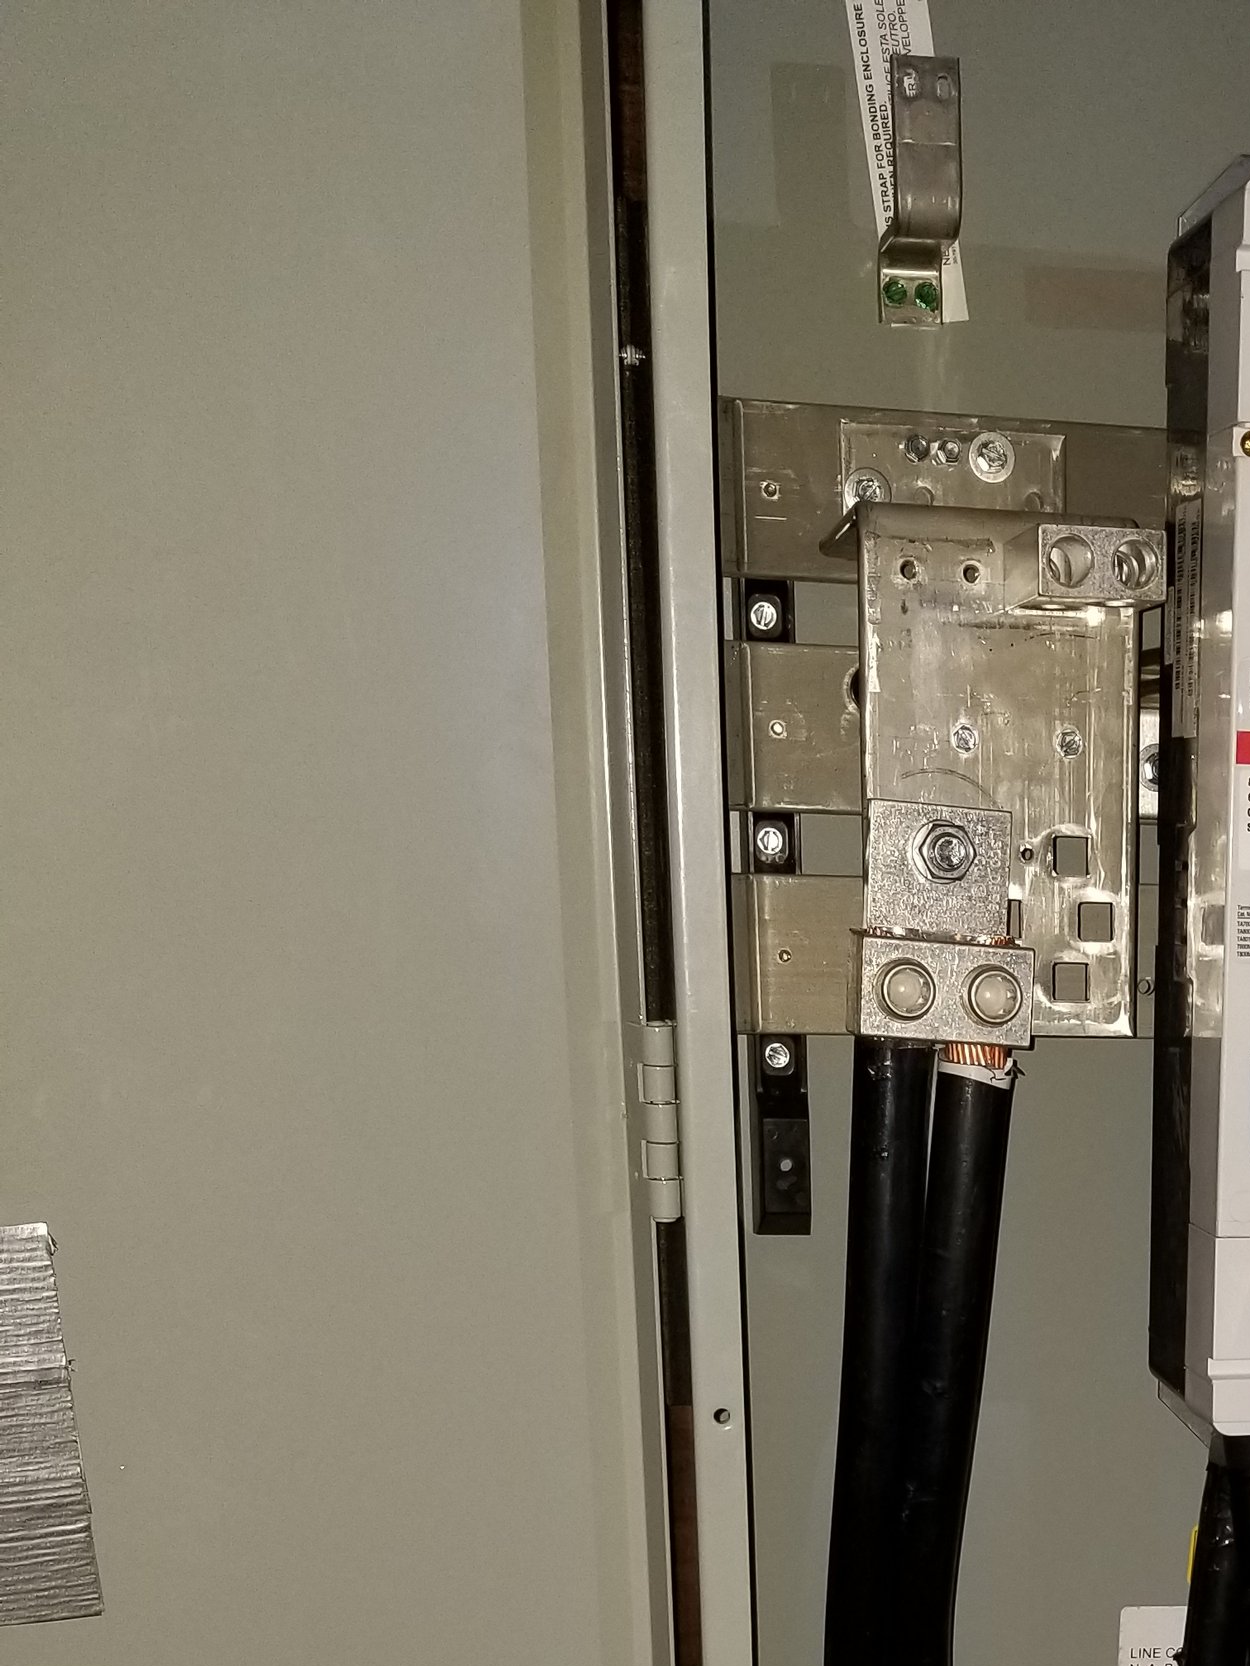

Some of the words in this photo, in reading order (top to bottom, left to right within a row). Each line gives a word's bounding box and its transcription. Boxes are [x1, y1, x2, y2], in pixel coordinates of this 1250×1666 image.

[853, 3, 873, 81] ENCLOSURE
[888, 11, 902, 55] EUTRO.
[865, 83, 882, 142] BONDING
[875, 144, 886, 170] FOR
[878, 173, 892, 212] STRAP
[1130, 1647, 1162, 1659] LINE
